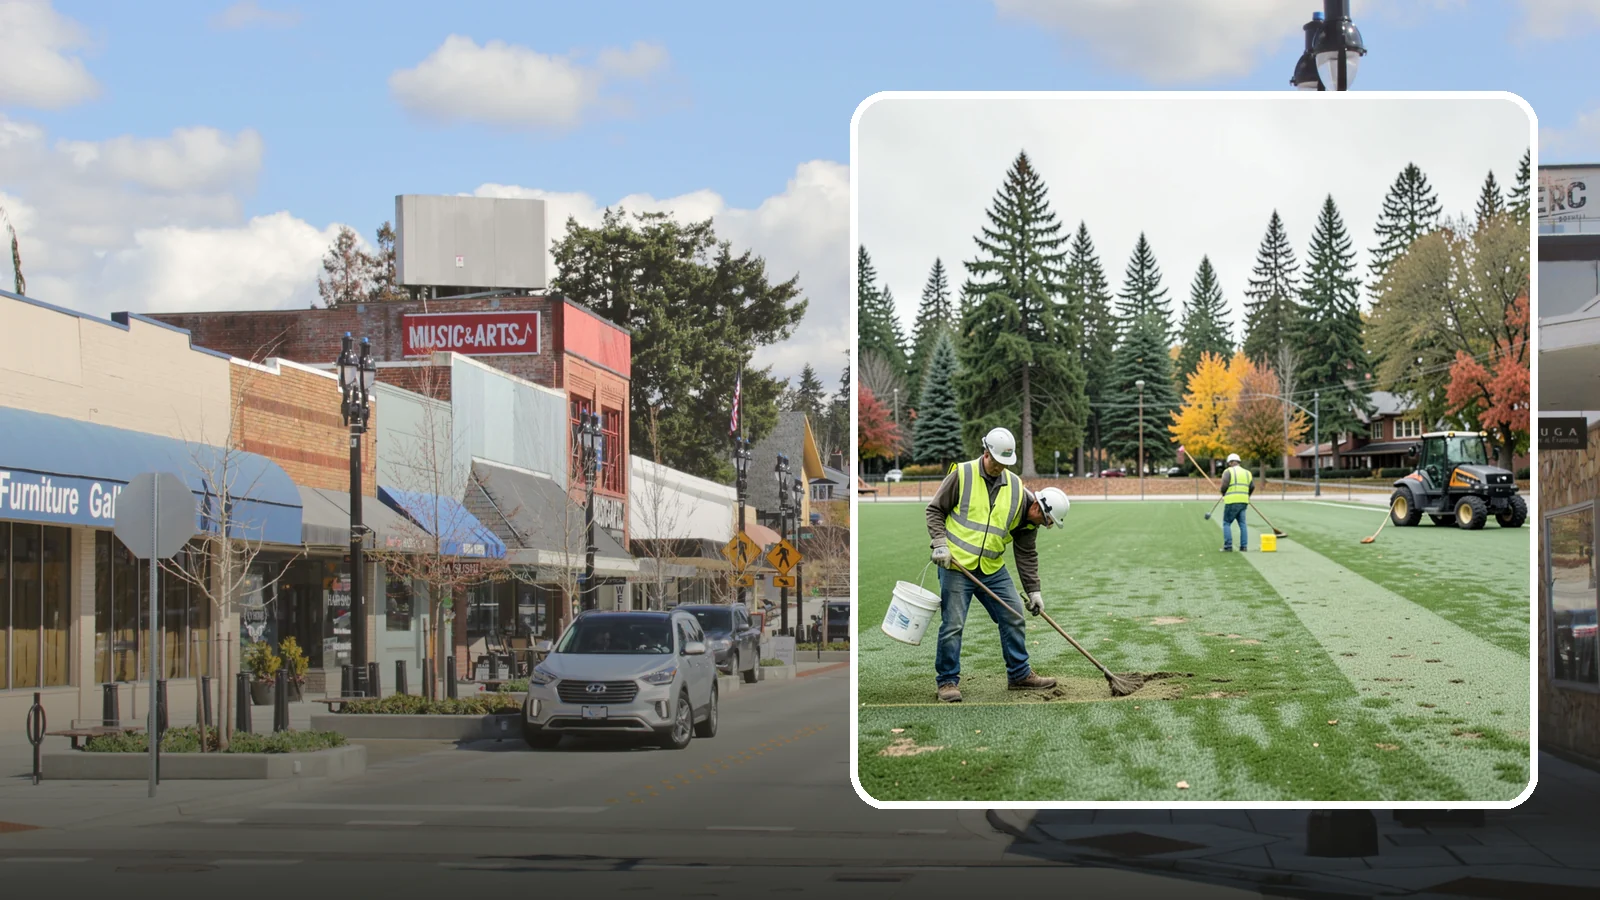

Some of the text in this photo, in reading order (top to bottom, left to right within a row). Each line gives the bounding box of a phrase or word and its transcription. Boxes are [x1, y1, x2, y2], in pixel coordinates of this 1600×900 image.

[0, 471, 122, 519] Furniture Gal
[453, 563, 479, 574] SUSHI
